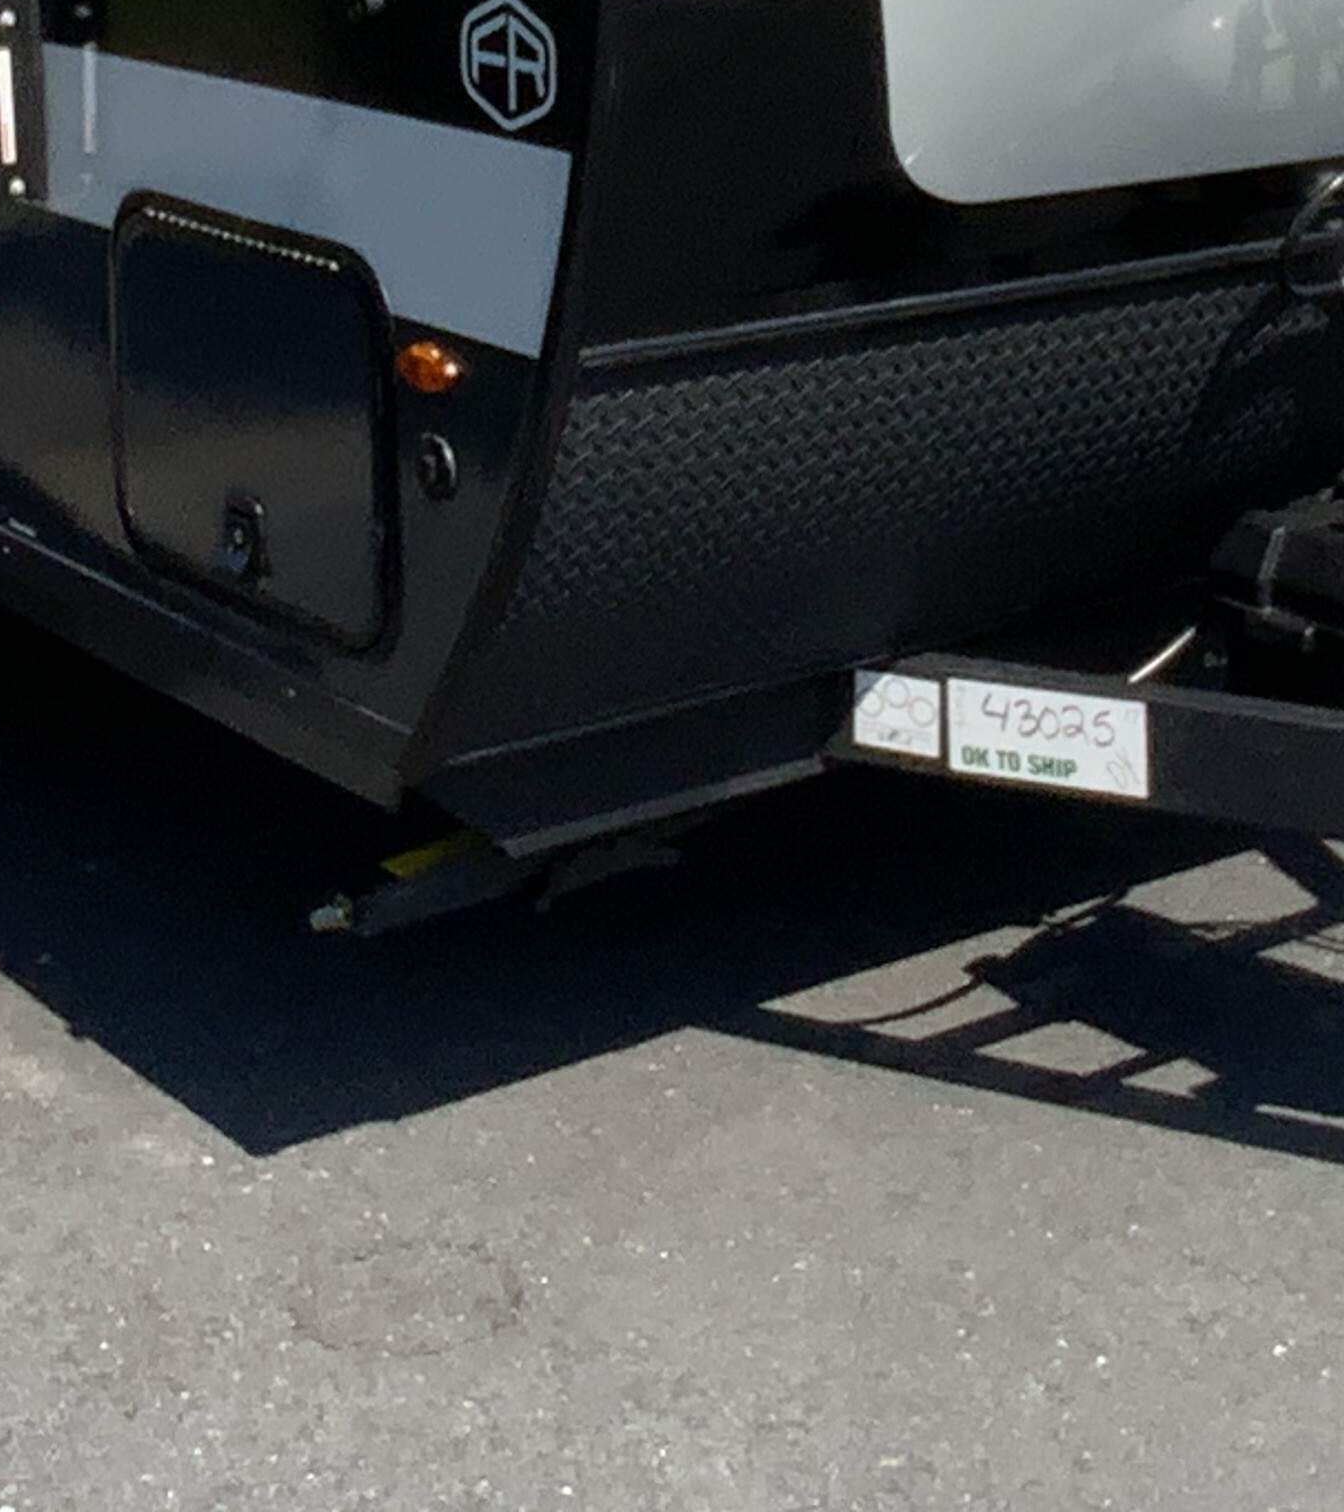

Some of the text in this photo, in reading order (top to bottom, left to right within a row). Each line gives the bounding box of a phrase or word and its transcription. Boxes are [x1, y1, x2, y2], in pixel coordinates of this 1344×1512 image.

[980, 693, 1116, 748] 43025
[961, 745, 1078, 779] OK TO SHIP
